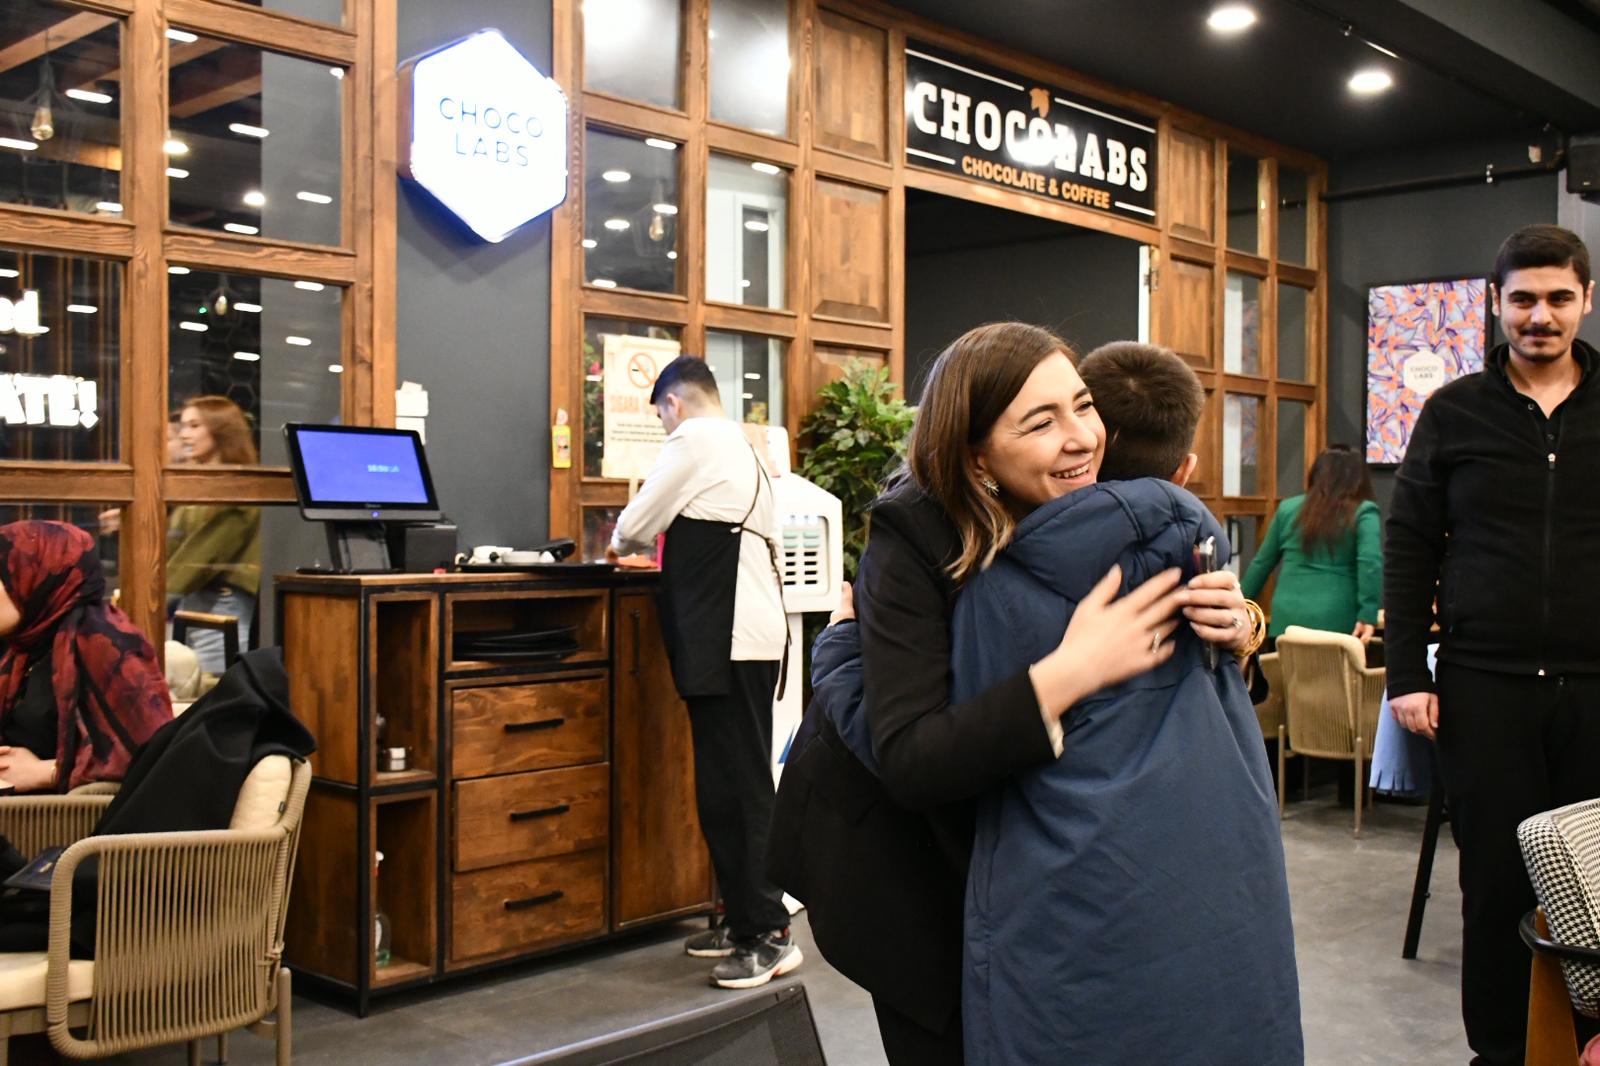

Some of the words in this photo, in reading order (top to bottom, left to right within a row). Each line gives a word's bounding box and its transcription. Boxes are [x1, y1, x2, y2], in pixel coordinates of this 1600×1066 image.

[440, 98, 543, 138] CHOCO
[455, 134, 528, 166] LABS
[961, 156, 1045, 192] CHOCOLATE
[1048, 178, 1059, 196] &
[1061, 182, 1111, 210] COFFEE
